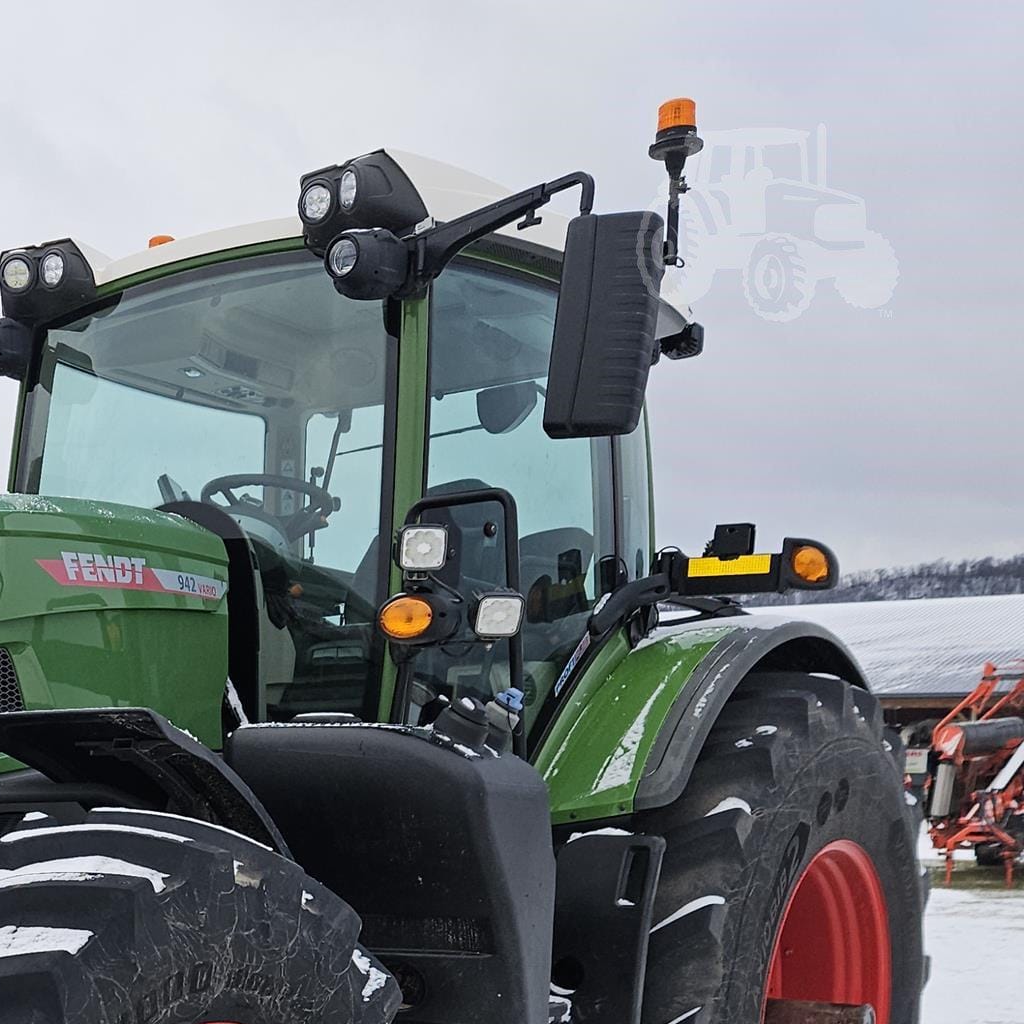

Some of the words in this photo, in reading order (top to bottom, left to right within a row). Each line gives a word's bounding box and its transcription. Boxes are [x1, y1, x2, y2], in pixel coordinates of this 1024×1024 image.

[60, 551, 146, 585] FENDT
[177, 575, 197, 593] 942
[197, 582, 217, 597] VARIO
